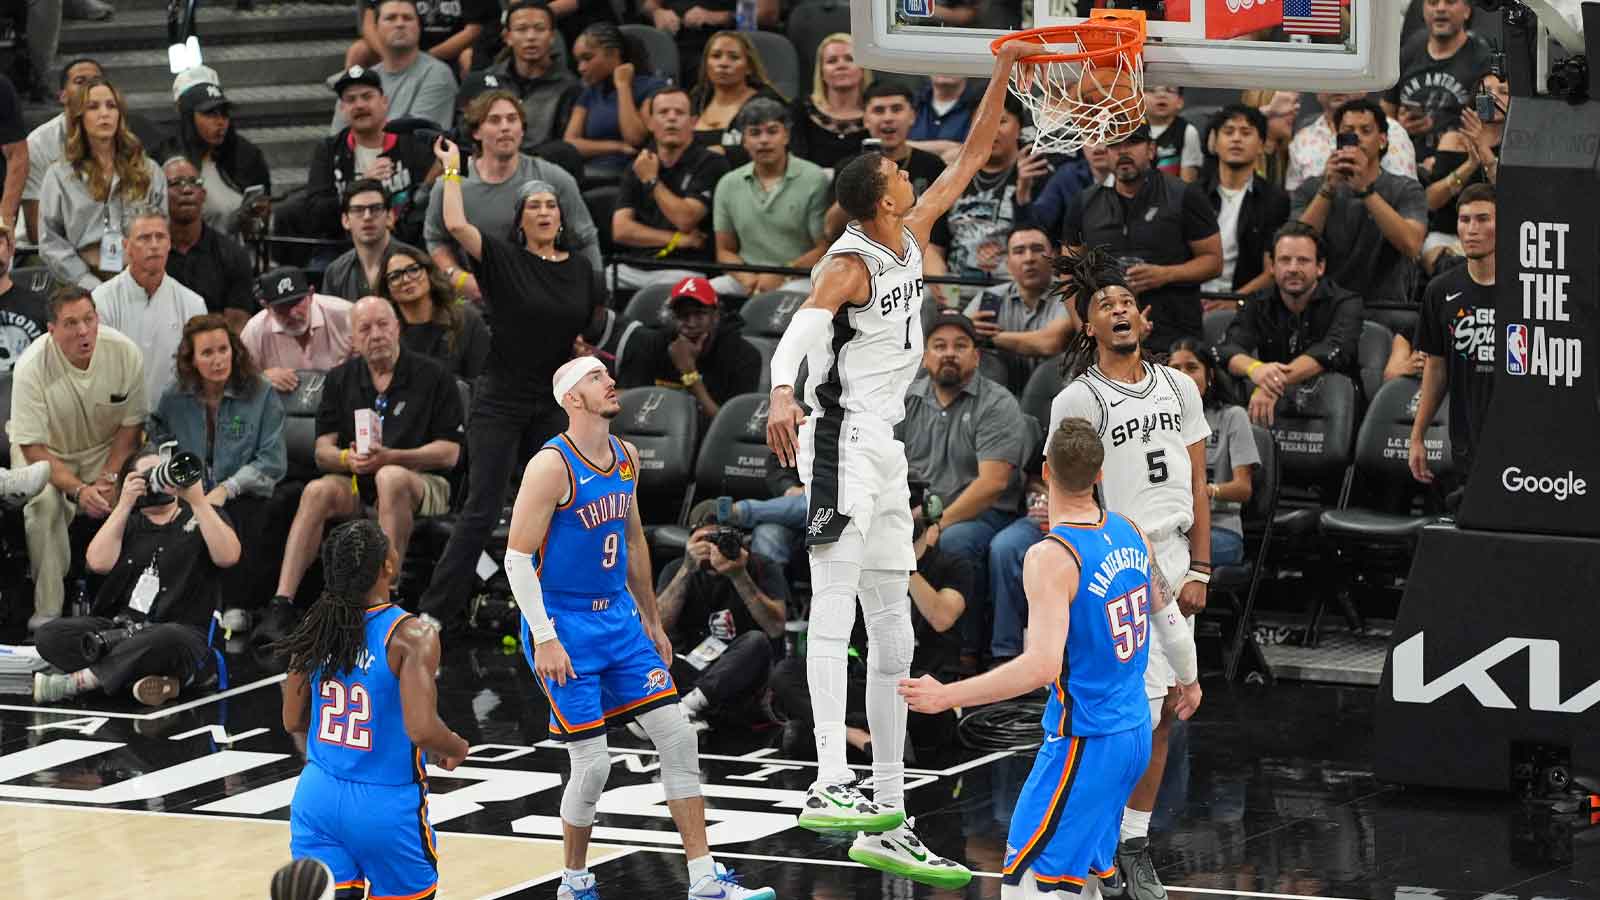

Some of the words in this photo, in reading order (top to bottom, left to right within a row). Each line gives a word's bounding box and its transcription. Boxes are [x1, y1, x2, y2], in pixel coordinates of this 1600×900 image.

[1519, 221, 1570, 270] GET
[1519, 273, 1570, 321] THE
[903, 315, 912, 350] 1
[1530, 326, 1582, 387] App
[1111, 412, 1181, 447] SPURS
[1146, 449, 1168, 484] 5
[1502, 467, 1587, 500] Google
[602, 533, 619, 569] 9
[1105, 583, 1148, 662] 55
[318, 679, 373, 752] 22
